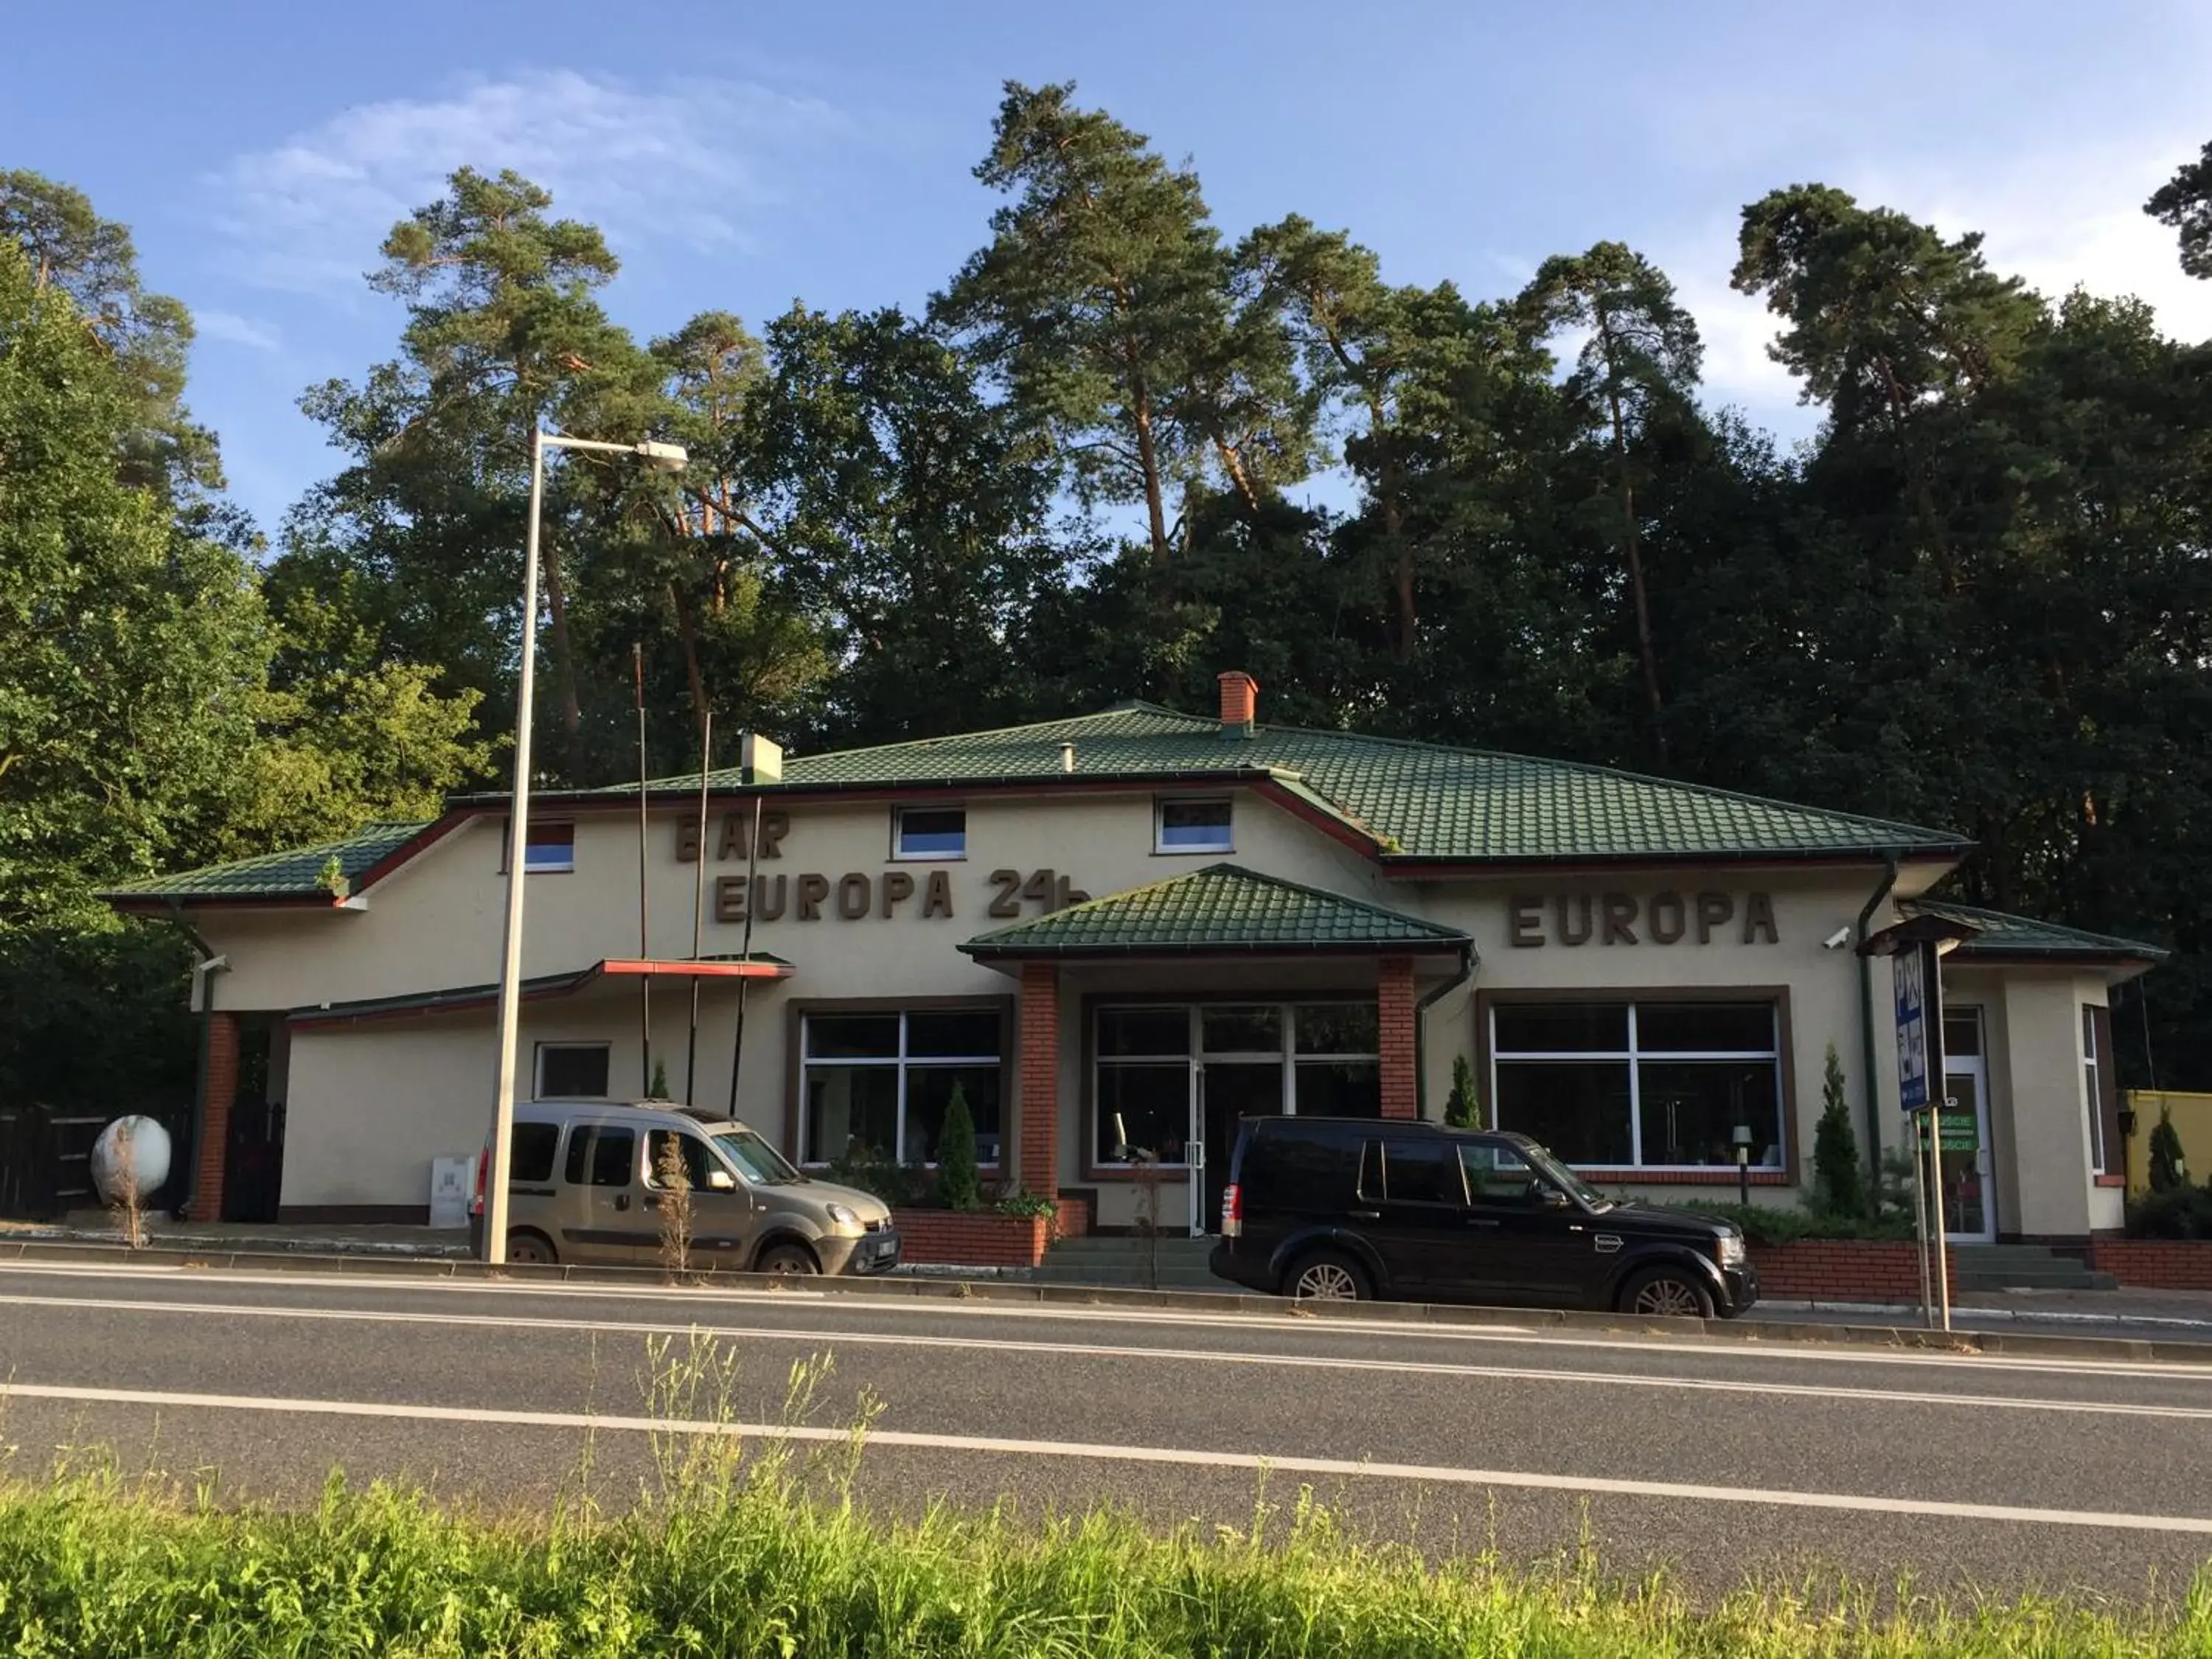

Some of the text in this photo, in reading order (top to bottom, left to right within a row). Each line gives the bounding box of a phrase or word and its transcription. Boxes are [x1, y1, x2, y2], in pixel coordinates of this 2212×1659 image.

[675, 812, 790, 863] BAR
[715, 870, 954, 922] EUROPA
[1509, 889, 1778, 947] EUROPA
